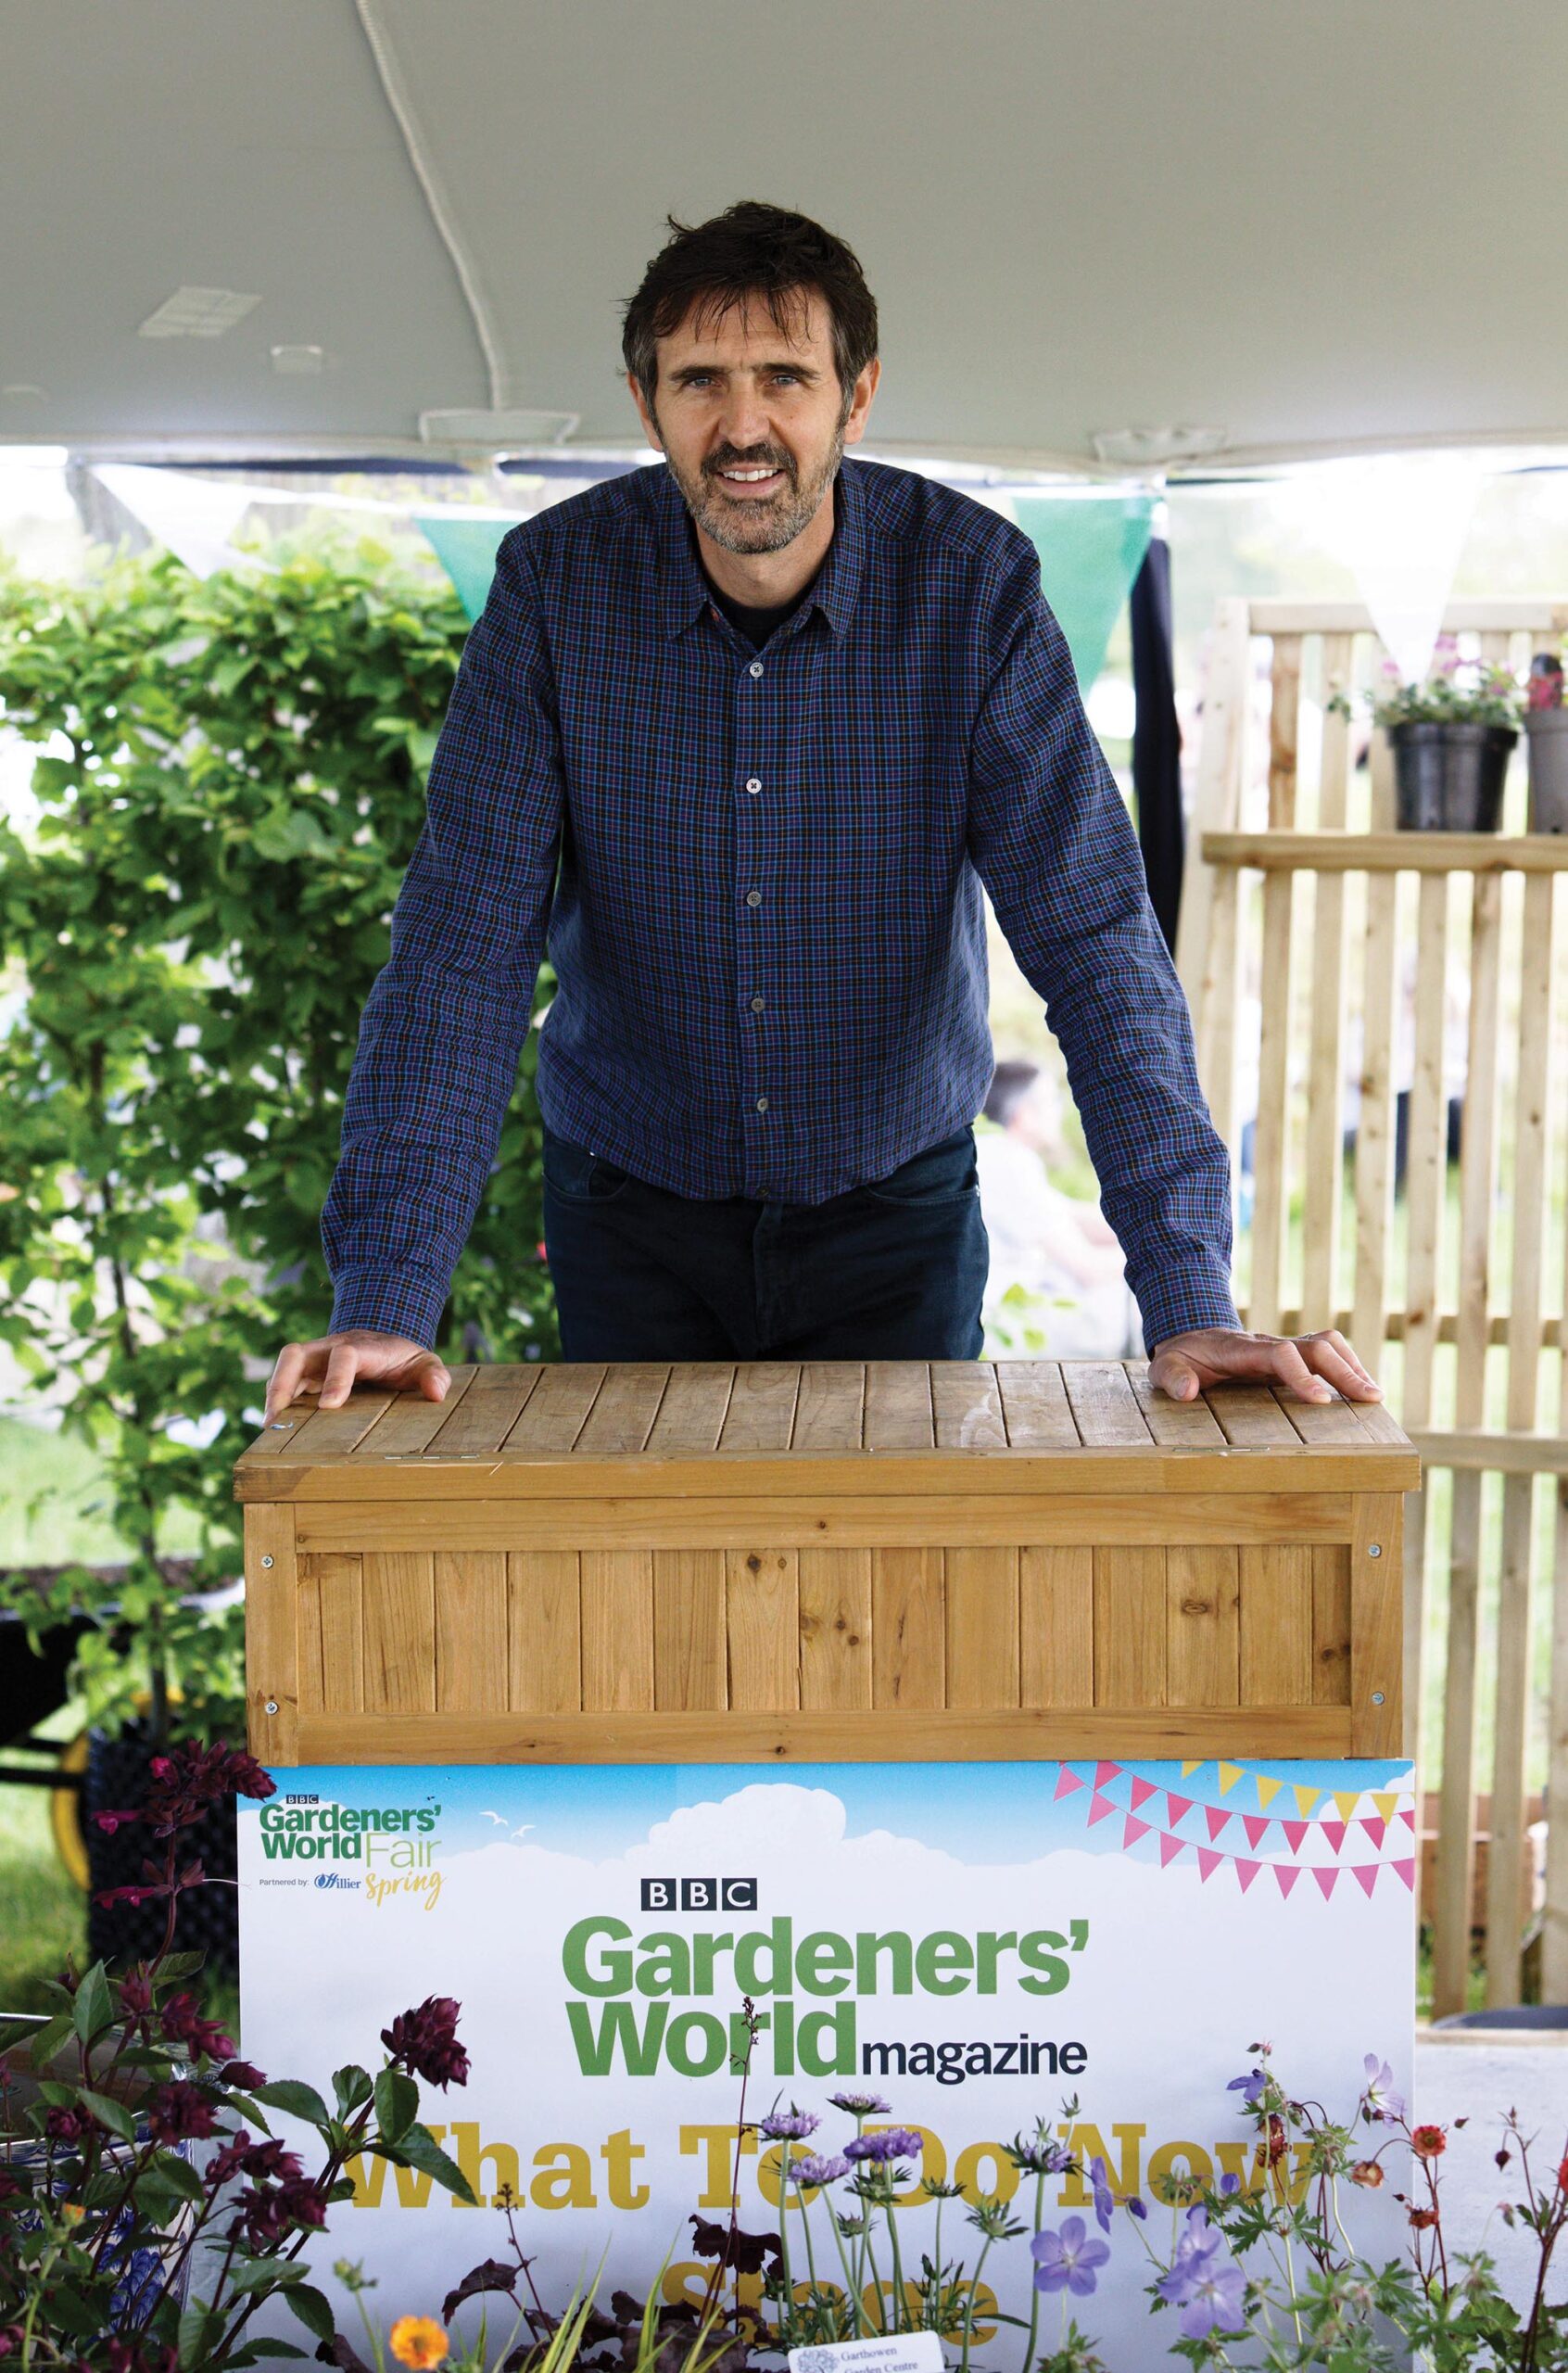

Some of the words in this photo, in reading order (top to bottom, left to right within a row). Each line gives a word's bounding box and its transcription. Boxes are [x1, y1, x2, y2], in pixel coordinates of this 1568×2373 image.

[285, 1794, 319, 1804] BBC
[259, 1804, 442, 1833] Gardeners’
[260, 1832, 361, 1859] World
[365, 1832, 442, 1868] Fair
[259, 1877, 297, 1886] Partnered
[298, 1877, 310, 1888] by:
[640, 1877, 758, 1911] BBC
[562, 1915, 1089, 1998] Gardeners’
[565, 2000, 857, 2077] World
[862, 2034, 1088, 2086] magazine
[343, 2121, 651, 2210] What
[679, 2124, 820, 2210] To
[862, 2124, 1020, 2208] Do
[1056, 2123, 1314, 2208] Now
[841, 2347, 897, 2362] Garthowen
[884, 2362, 918, 2372] Centre
